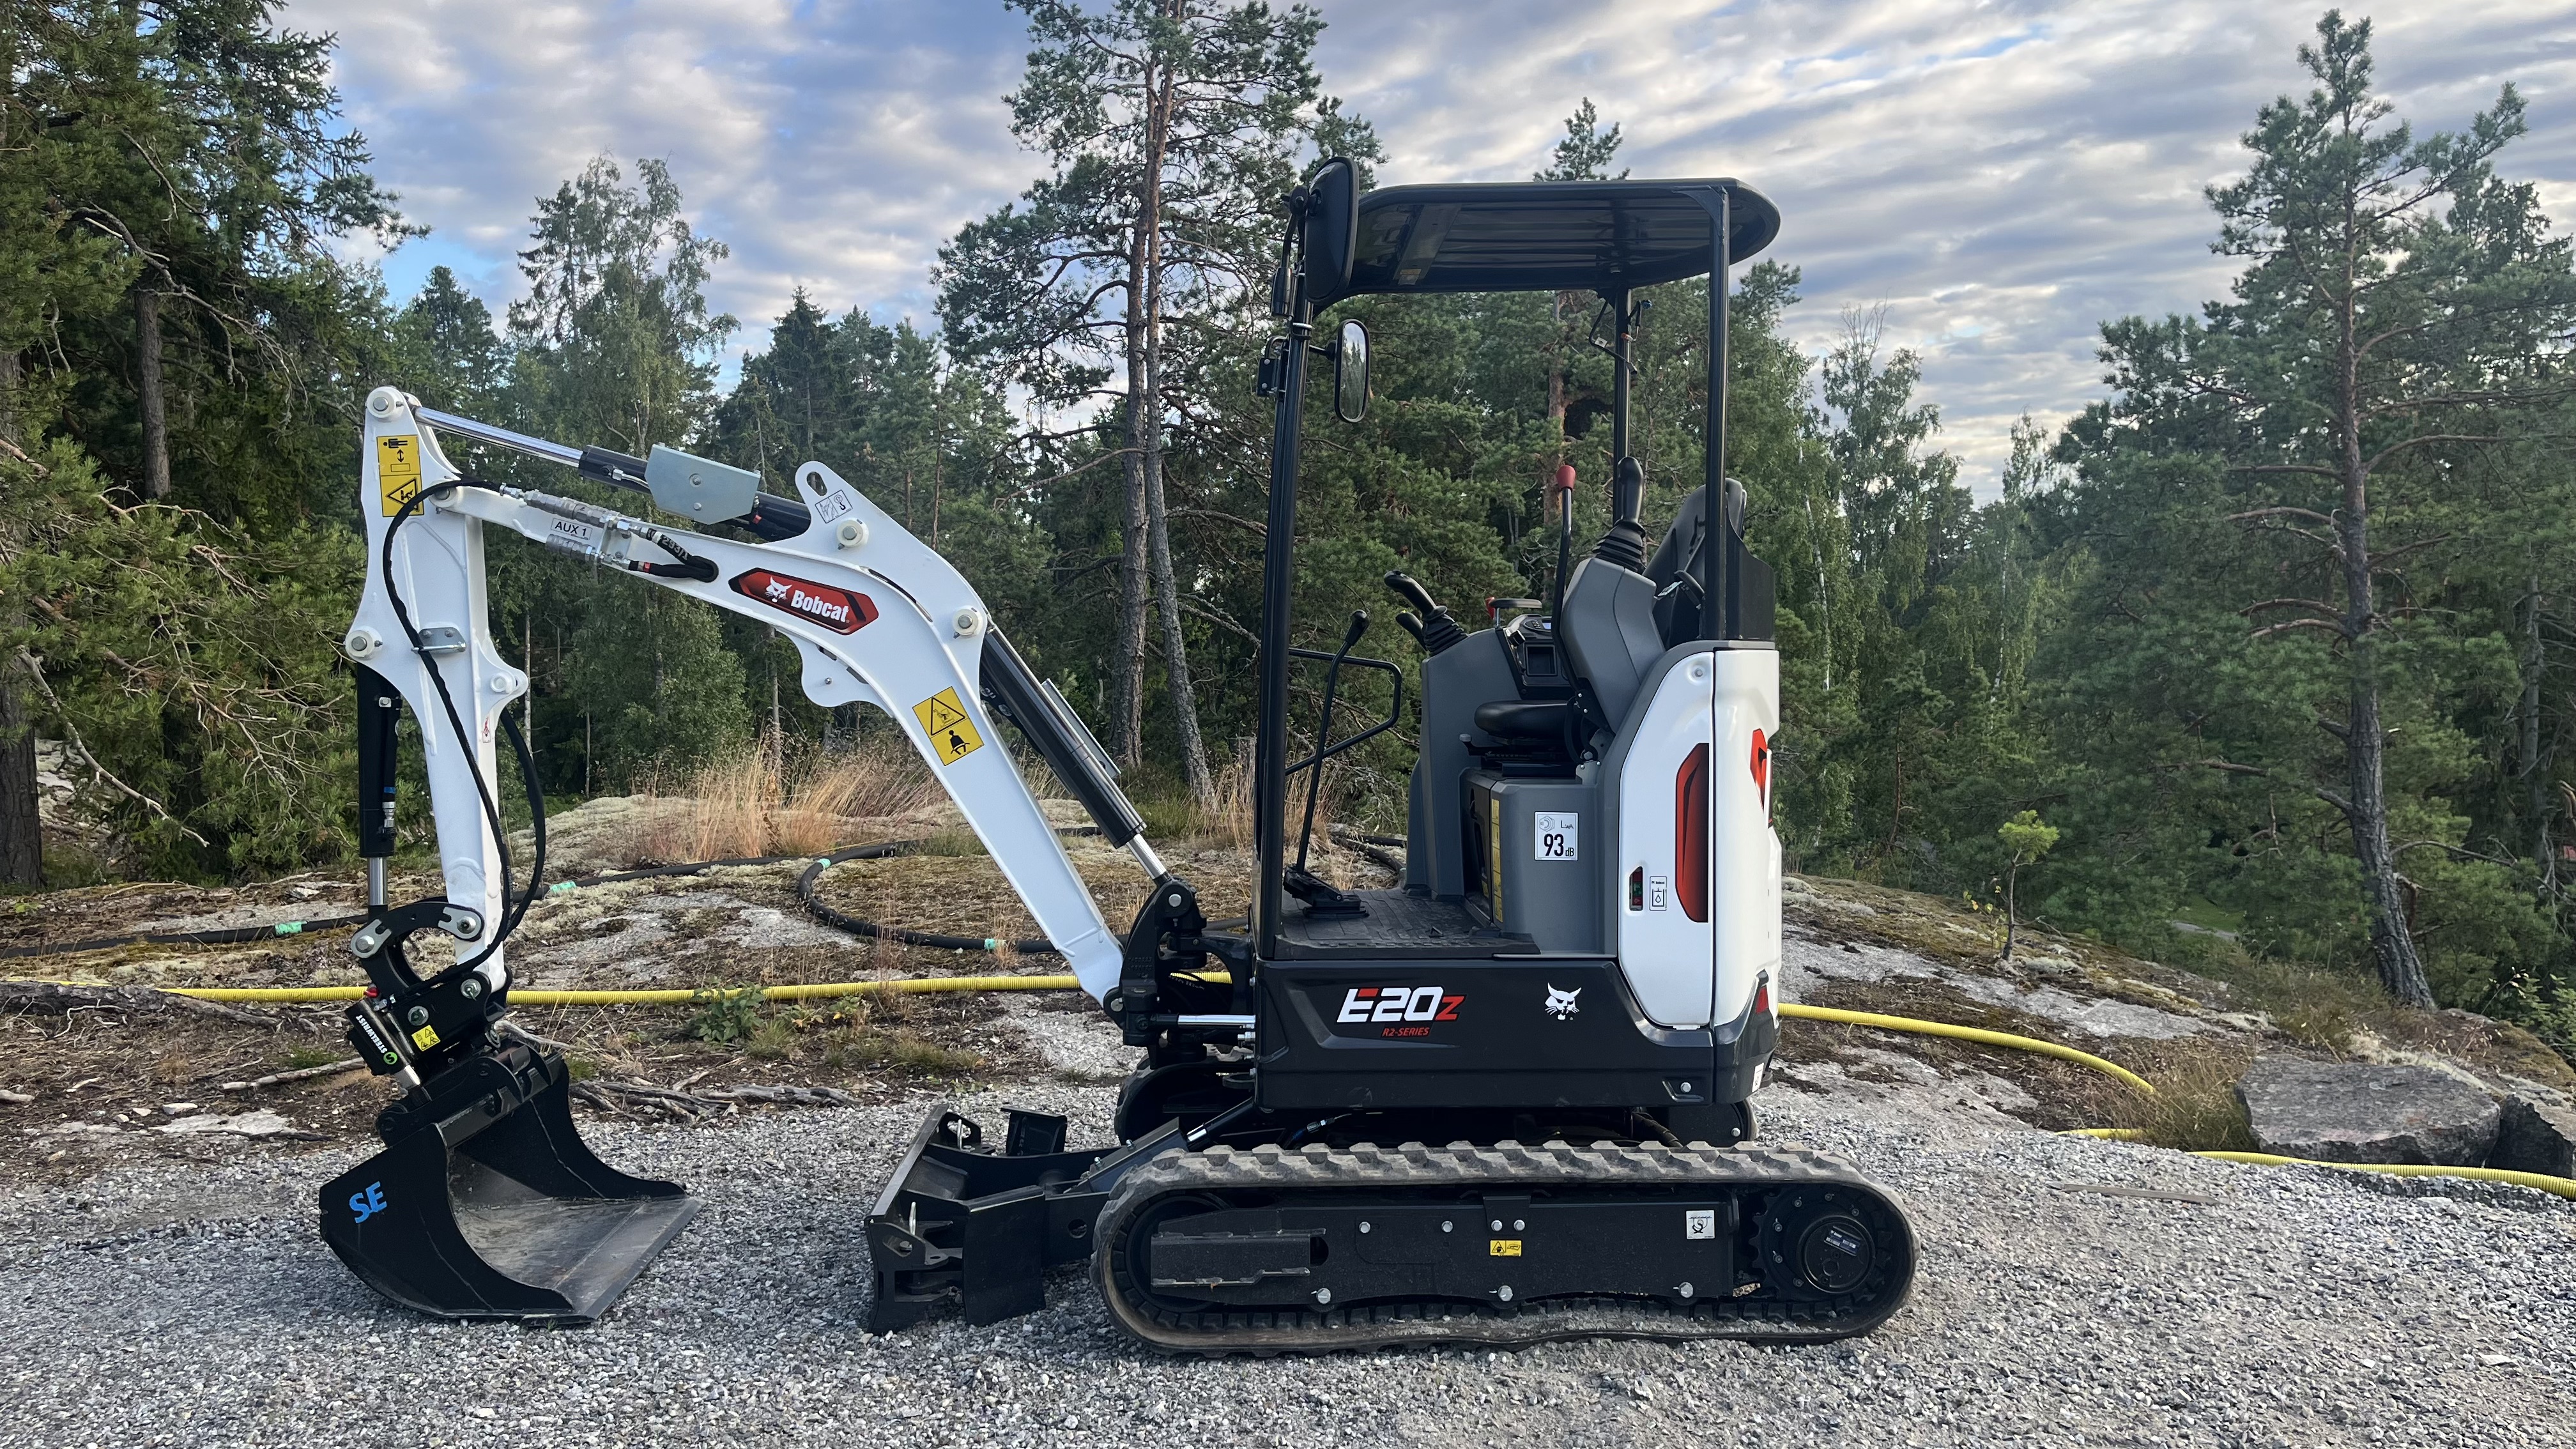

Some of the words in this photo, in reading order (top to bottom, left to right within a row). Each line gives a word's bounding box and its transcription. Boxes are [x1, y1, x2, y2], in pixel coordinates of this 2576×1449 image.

[555, 521, 579, 534] AUX
[582, 528, 586, 536] 1
[790, 590, 849, 623] Bobcat
[1544, 833, 1564, 857] 93
[1565, 847, 1574, 857] dB
[355, 1015, 388, 1054] STEELWRIST
[1382, 1027, 1430, 1037] R2-SERIES
[349, 1181, 387, 1223] SE
